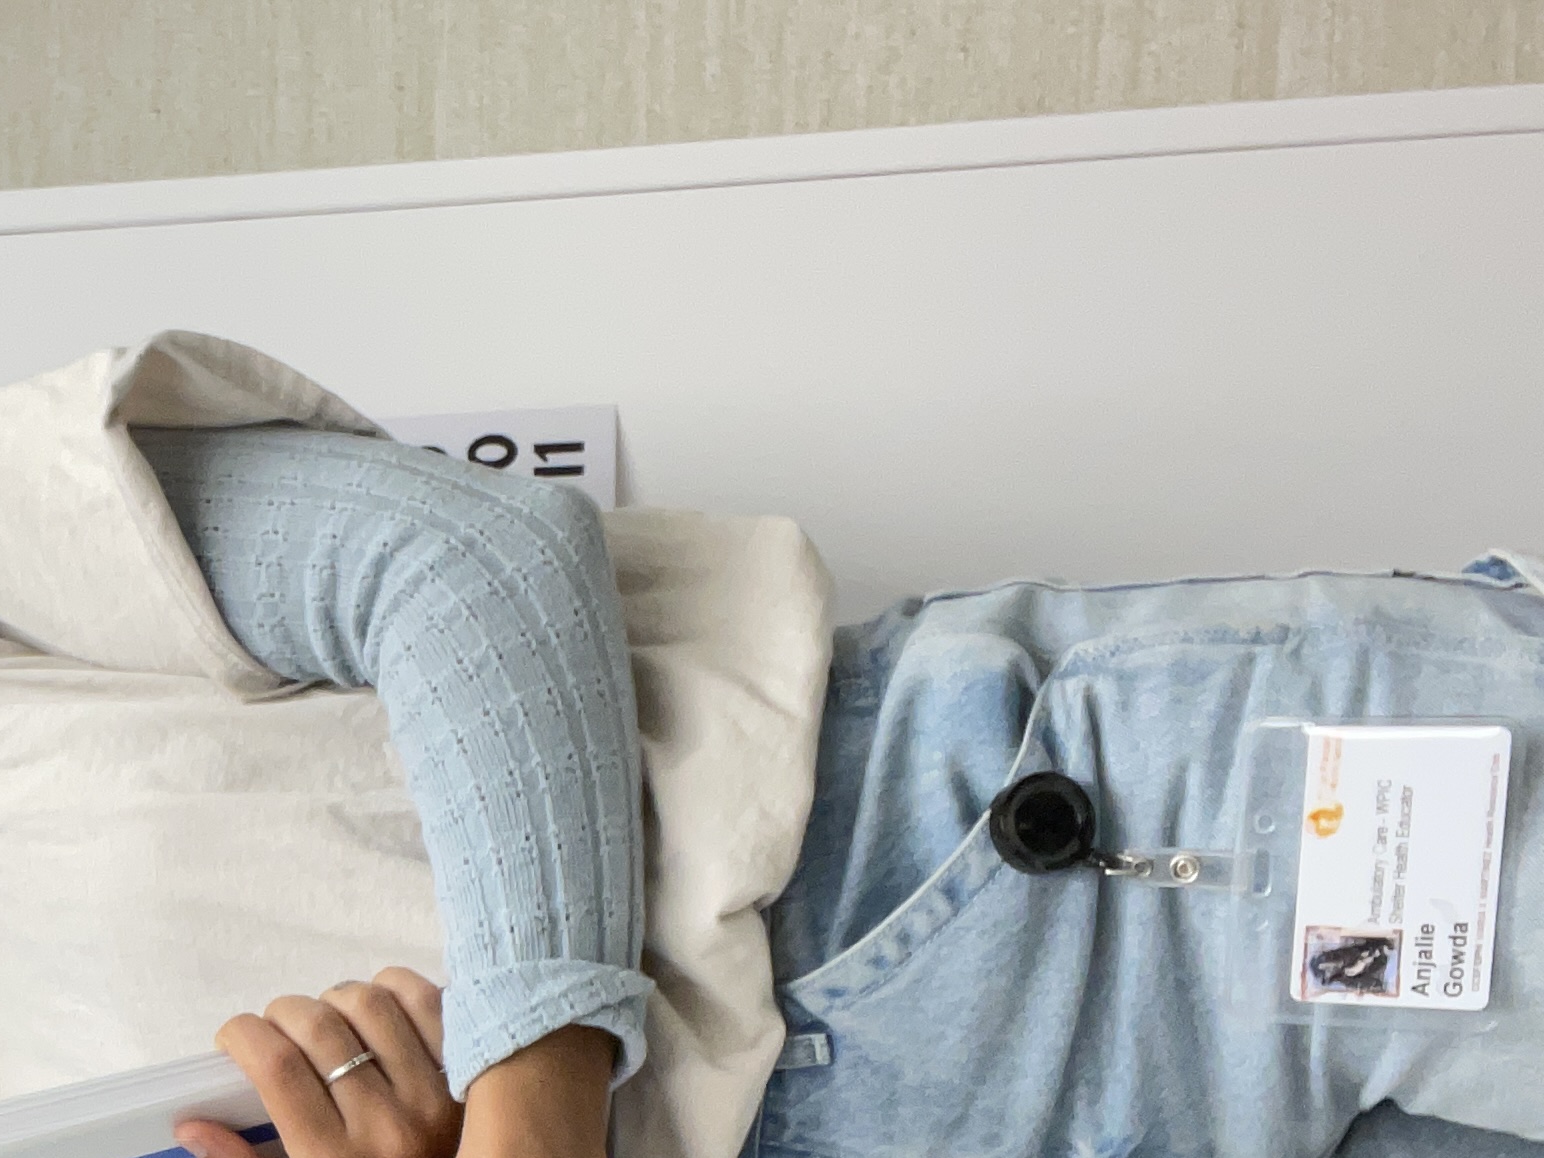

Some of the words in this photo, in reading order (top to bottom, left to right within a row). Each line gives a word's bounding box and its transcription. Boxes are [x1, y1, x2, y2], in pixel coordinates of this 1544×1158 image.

[466, 434, 518, 469] 0
[1395, 785, 1414, 838] Educator
[1372, 826, 1389, 854] Care
[1392, 842, 1410, 880] Health
[1388, 883, 1406, 924] Shelter
[1410, 922, 1437, 998] Anjalie
[1443, 921, 1469, 999] Gowda
